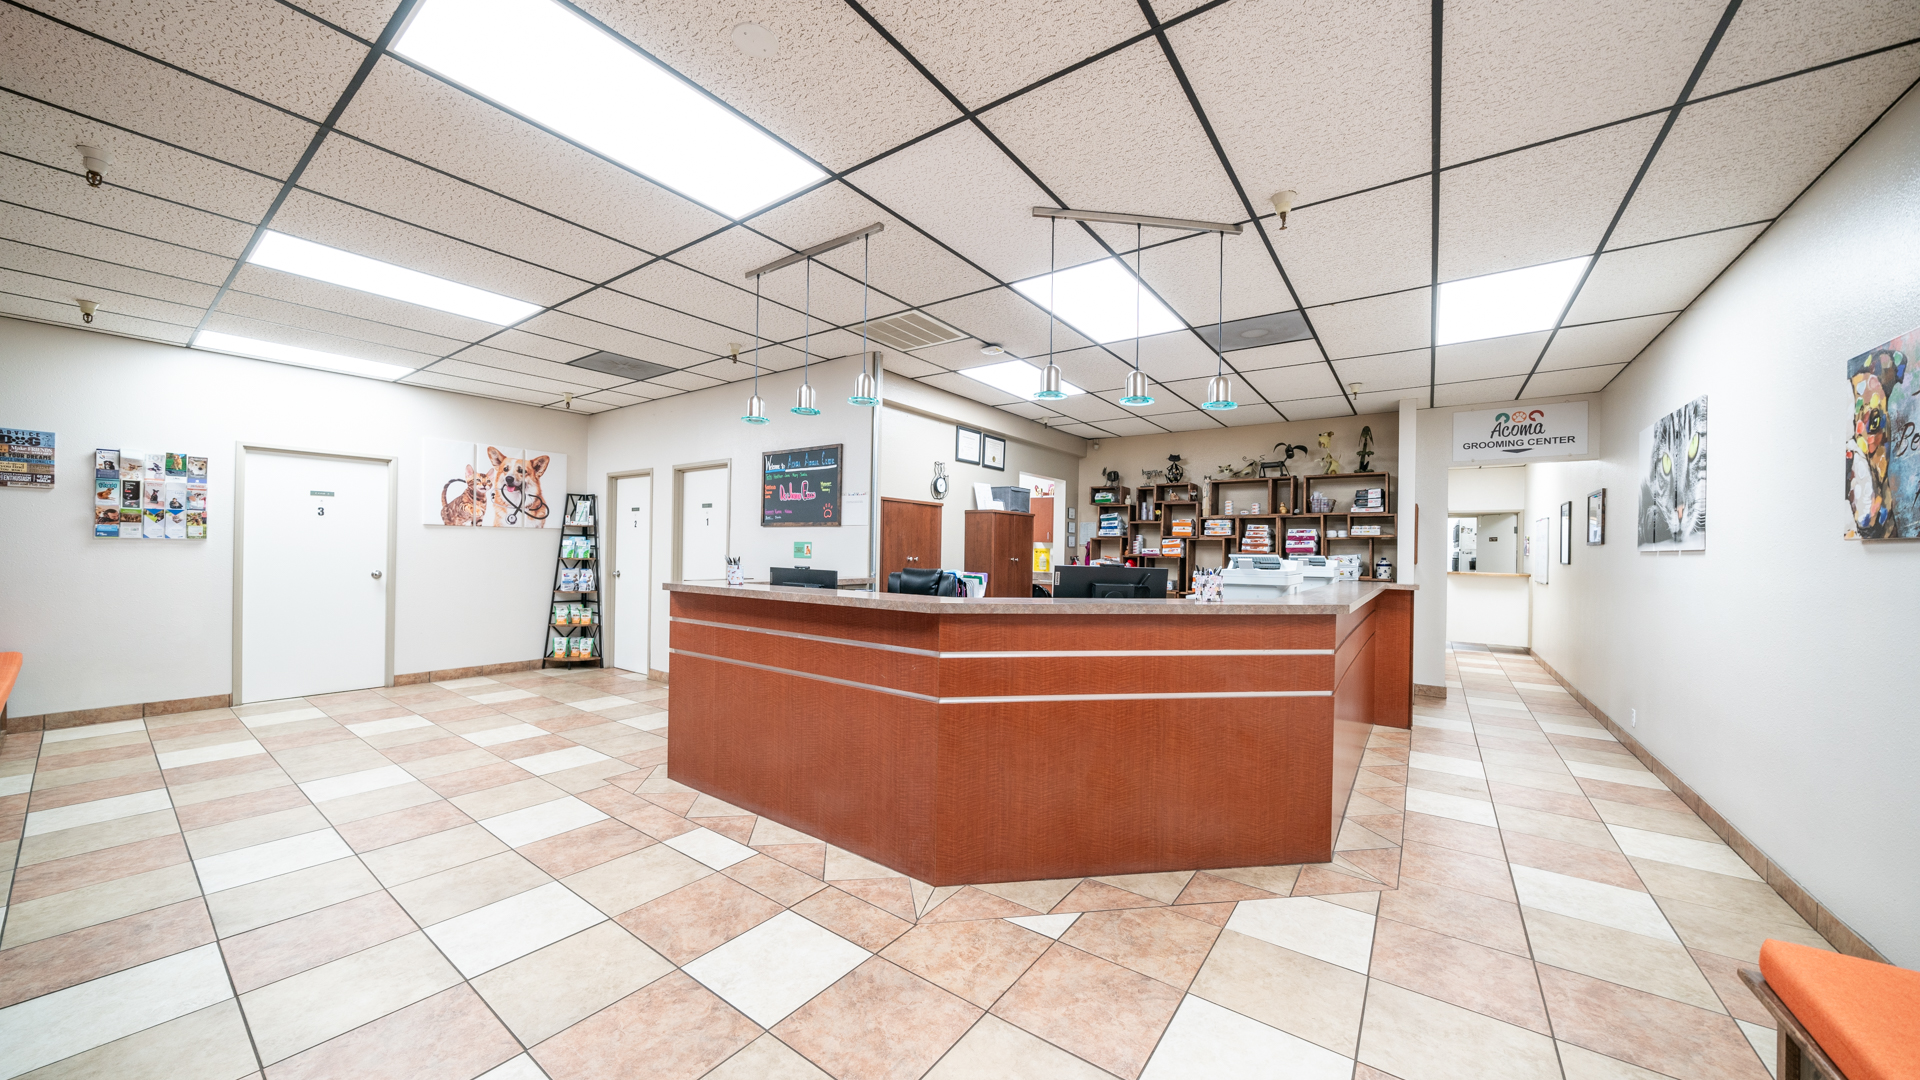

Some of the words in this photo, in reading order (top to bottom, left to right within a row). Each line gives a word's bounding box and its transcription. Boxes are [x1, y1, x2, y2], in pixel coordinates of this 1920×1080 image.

[1490, 422, 1545, 439] Acoma
[1463, 439, 1524, 450] GROOMING
[1528, 435, 1576, 446] CENTER
[317, 507, 325, 516] 3
[634, 520, 638, 528] 2
[706, 518, 709, 526] 1
